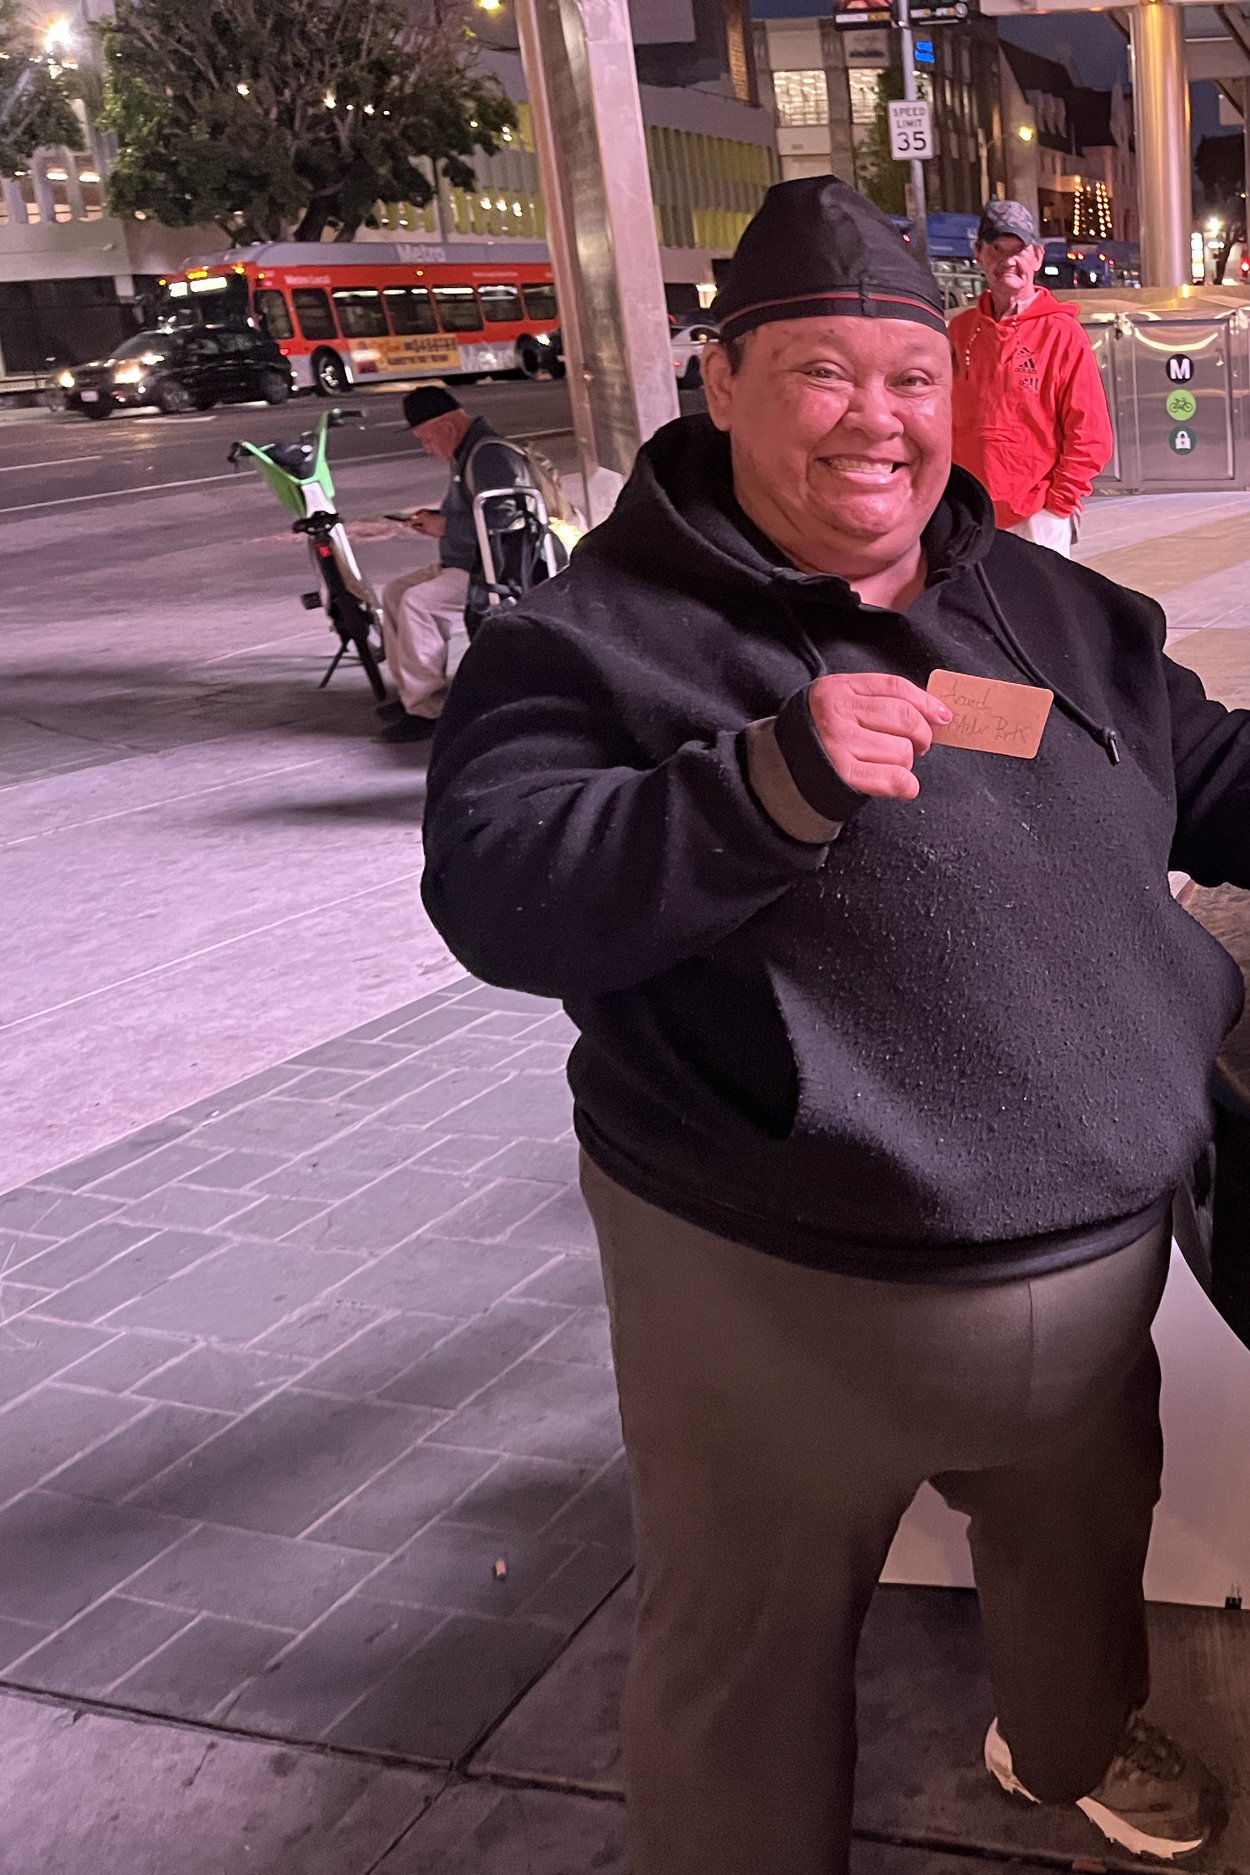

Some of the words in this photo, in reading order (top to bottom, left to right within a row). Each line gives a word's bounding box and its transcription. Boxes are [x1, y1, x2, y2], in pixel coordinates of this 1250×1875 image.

[892, 106, 926, 117] SPEED
[896, 119, 922, 129] LIMIT
[897, 131, 927, 151] 35
[396, 244, 446, 262] Metro
[1169, 358, 1191, 380] M
